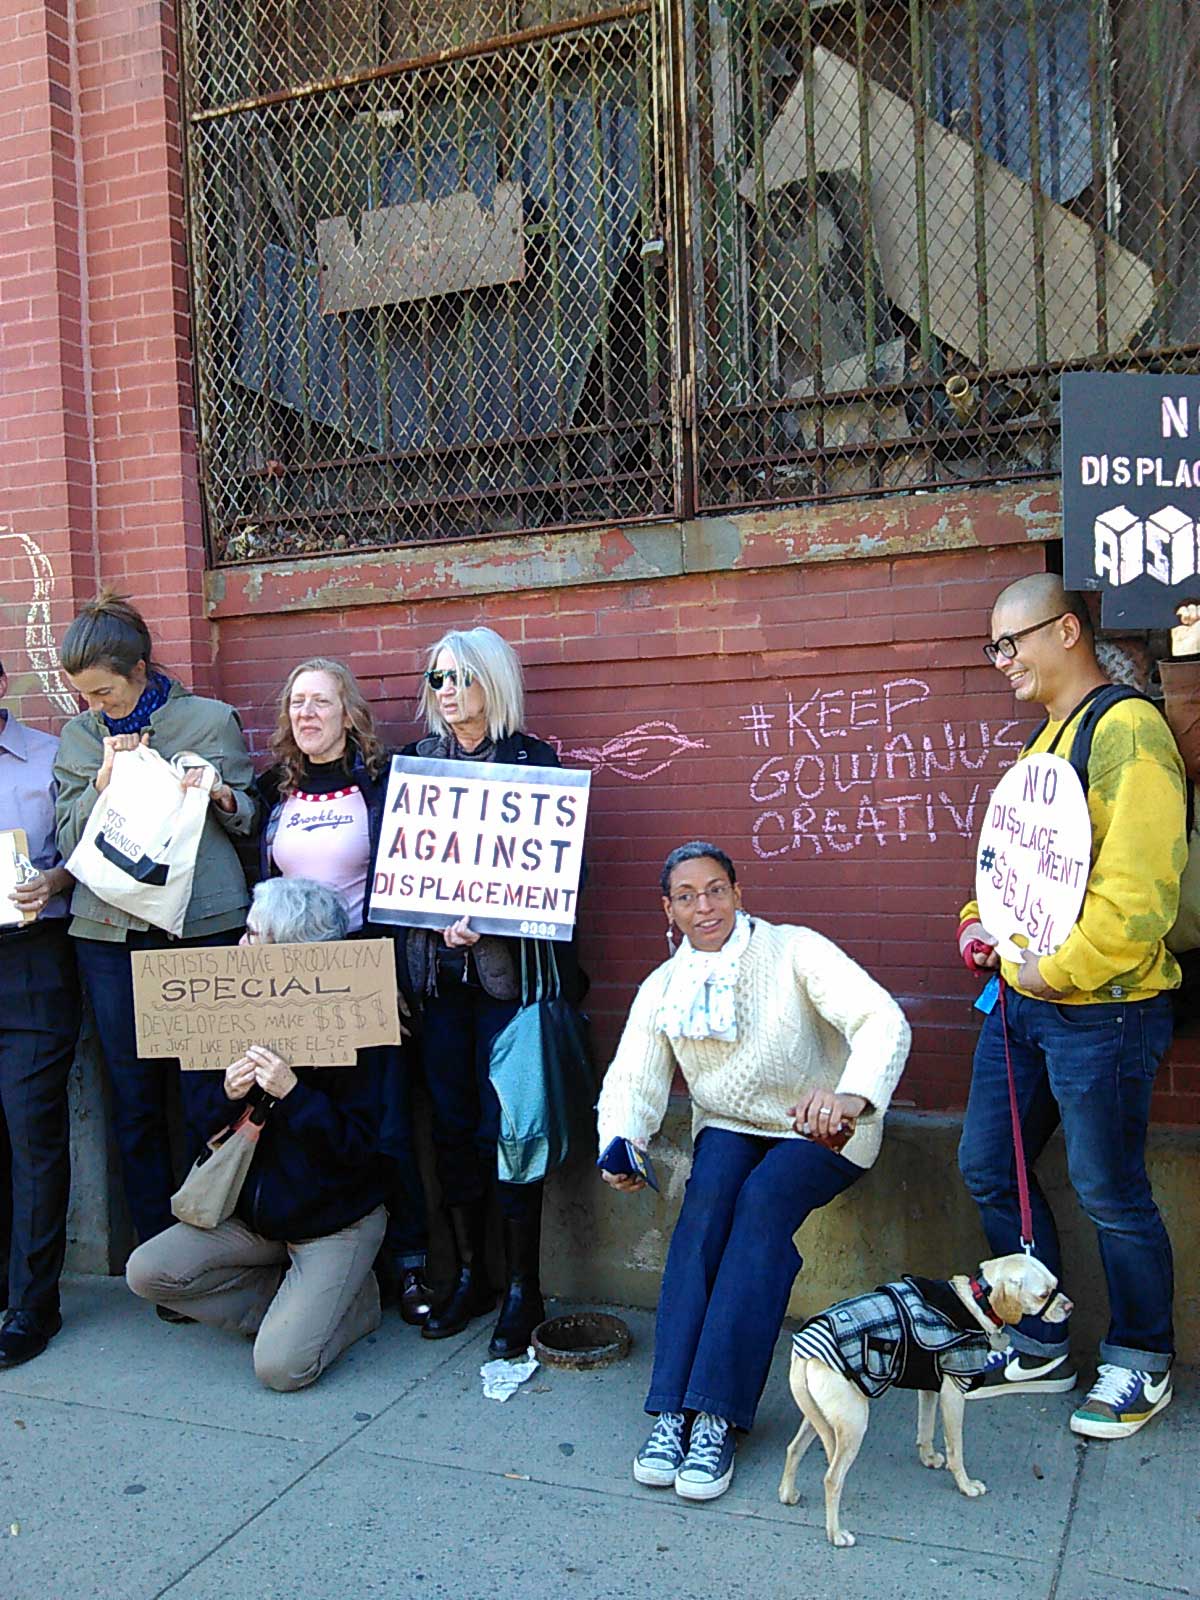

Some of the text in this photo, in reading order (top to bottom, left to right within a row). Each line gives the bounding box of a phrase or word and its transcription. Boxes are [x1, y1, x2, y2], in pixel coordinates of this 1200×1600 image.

[1162, 396, 1200, 438] N
[739, 677, 930, 749] #KEEP
[750, 719, 1023, 802] GOWANUS
[1022, 764, 1058, 806] NO
[106, 808, 127, 829] RTS
[286, 809, 354, 831] Brooklyn
[391, 782, 577, 828] ARTISTS
[751, 783, 994, 858] CREATIV
[102, 822, 142, 857] WANUS
[387, 826, 572, 874] AGAINST
[1037, 850, 1084, 889] MENT
[372, 872, 576, 912] DISPLACEMENT
[140, 943, 383, 979] ARTISTS MAKE BROOKLYN
[160, 975, 351, 1003] SPECIAL
[142, 1012, 256, 1039] DEVELOPERS
[264, 1013, 305, 1030] MAKE
[166, 1036, 193, 1052] JUST
[200, 1038, 222, 1055] LIKE
[305, 1033, 349, 1052] ELSE
